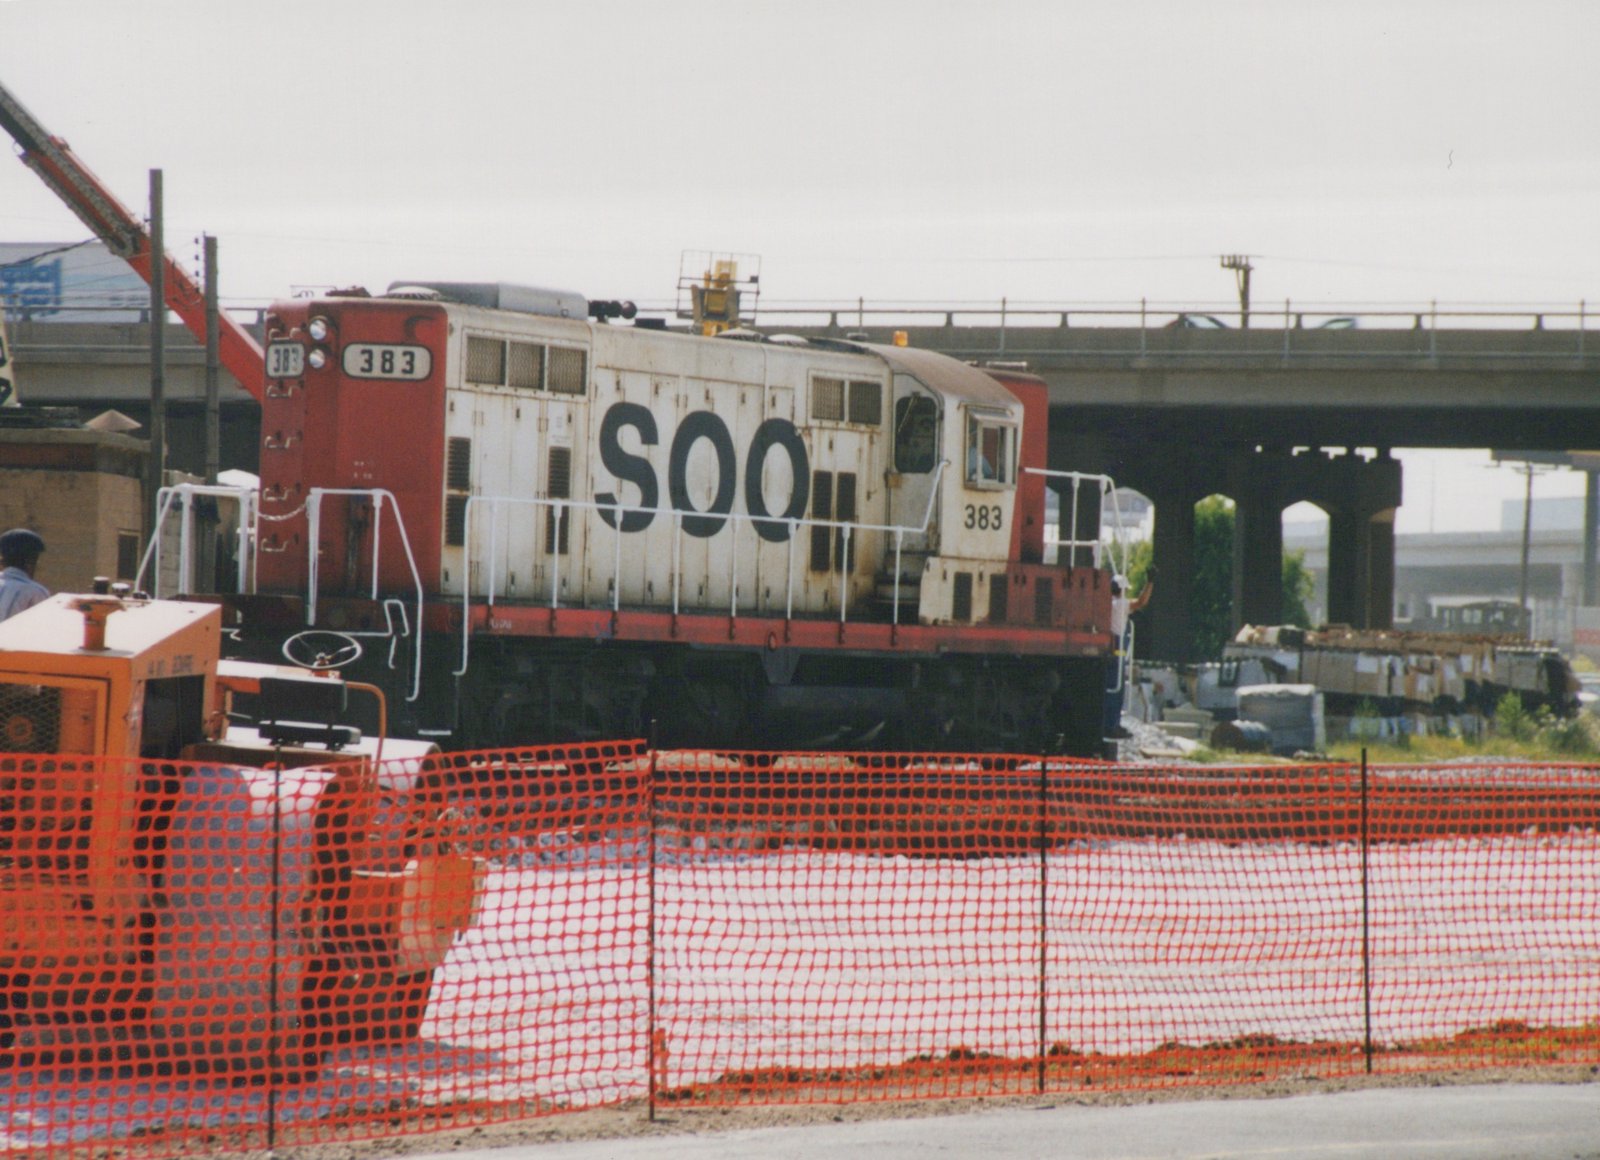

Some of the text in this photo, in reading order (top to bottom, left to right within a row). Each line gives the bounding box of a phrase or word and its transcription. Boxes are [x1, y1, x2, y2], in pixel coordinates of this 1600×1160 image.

[360, 349, 416, 375] 383
[594, 402, 810, 543] SOO
[964, 503, 1002, 531] 383
